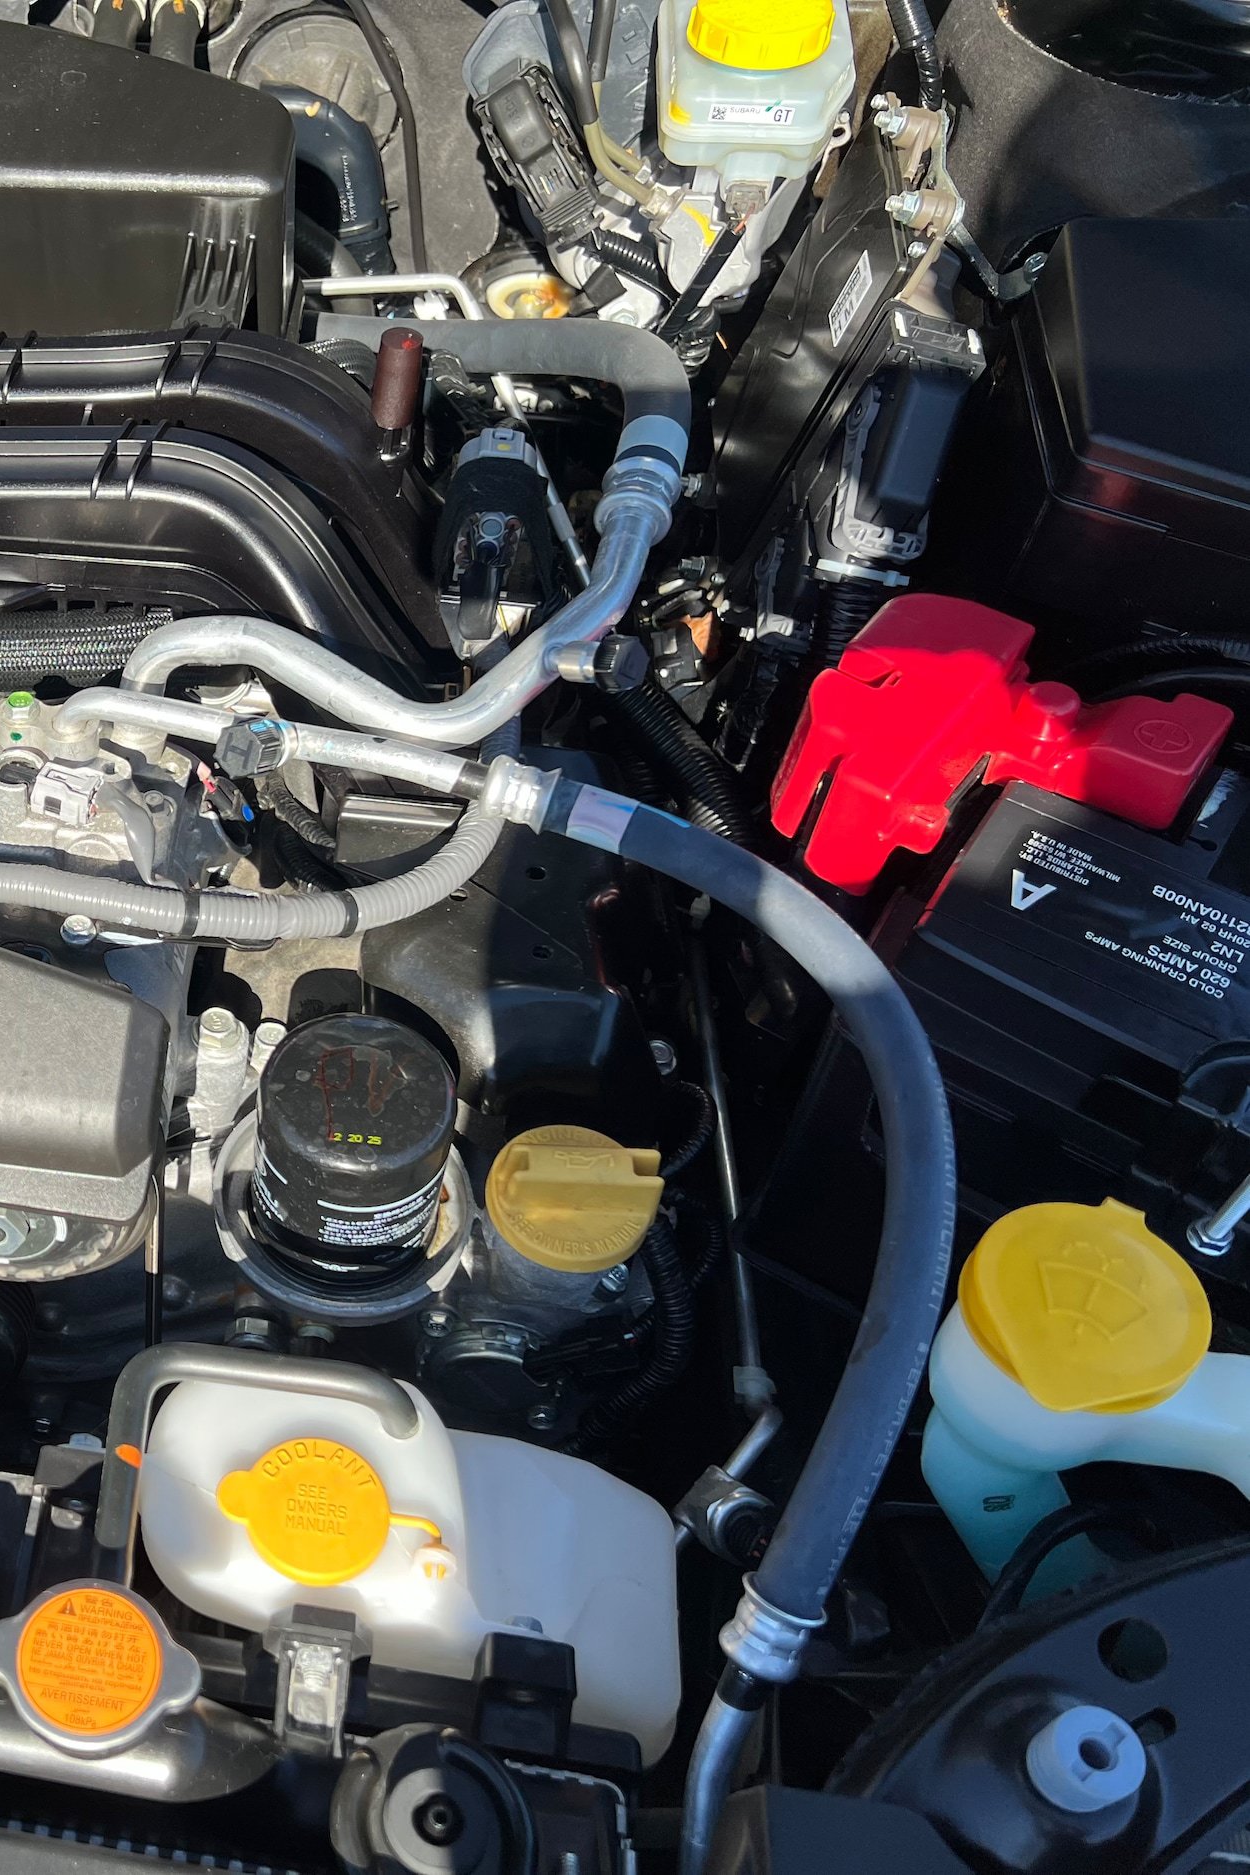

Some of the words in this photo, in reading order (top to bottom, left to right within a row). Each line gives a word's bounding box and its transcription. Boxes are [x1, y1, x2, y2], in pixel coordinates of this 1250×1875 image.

[730, 106, 761, 114] SUBARU
[773, 109, 792, 122] GT
[222, 732, 253, 770] H
[1029, 829, 1056, 846] U.S.A.
[1055, 840, 1067, 850] IN
[1017, 849, 1033, 862] BY:
[1053, 848, 1066, 859] WI
[1066, 845, 1092, 861] MADE
[1033, 856, 1089, 886] DISTRIBUTED
[1179, 910, 1200, 925] AH
[1200, 919, 1217, 933] 62
[1083, 929, 1121, 952] AMPS
[1161, 934, 1191, 953] SIZE
[1217, 927, 1250, 949] 20HR
[1145, 943, 1199, 974] AMPS
[1190, 947, 1238, 974] GROUP
[1208, 939, 1245, 963] LN2
[1120, 946, 1188, 982] CRANKING
[1187, 976, 1225, 999] COLD
[1199, 966, 1231, 988] 620
[347, 1133, 364, 1144] 20
[367, 1135, 382, 1146] 25
[509, 1212, 535, 1235] SEE
[532, 1230, 592, 1256] OWNER'S
[593, 1219, 642, 1256] MANUAL
[263, 1440, 378, 1489] COOLANT
[298, 1483, 328, 1500] SEE
[286, 1498, 348, 1520] OWNERS
[285, 1514, 347, 1537] MANUAL
[78, 1603, 133, 1620] WARNING
[31, 1646, 42, 1655] NE
[33, 1638, 63, 1649] NEVER
[66, 1643, 91, 1654] OPEN
[94, 1648, 122, 1660] WHEN
[39, 1687, 125, 1711] AVERTISSEMENT
[64, 1712, 97, 1727] 108kPa
